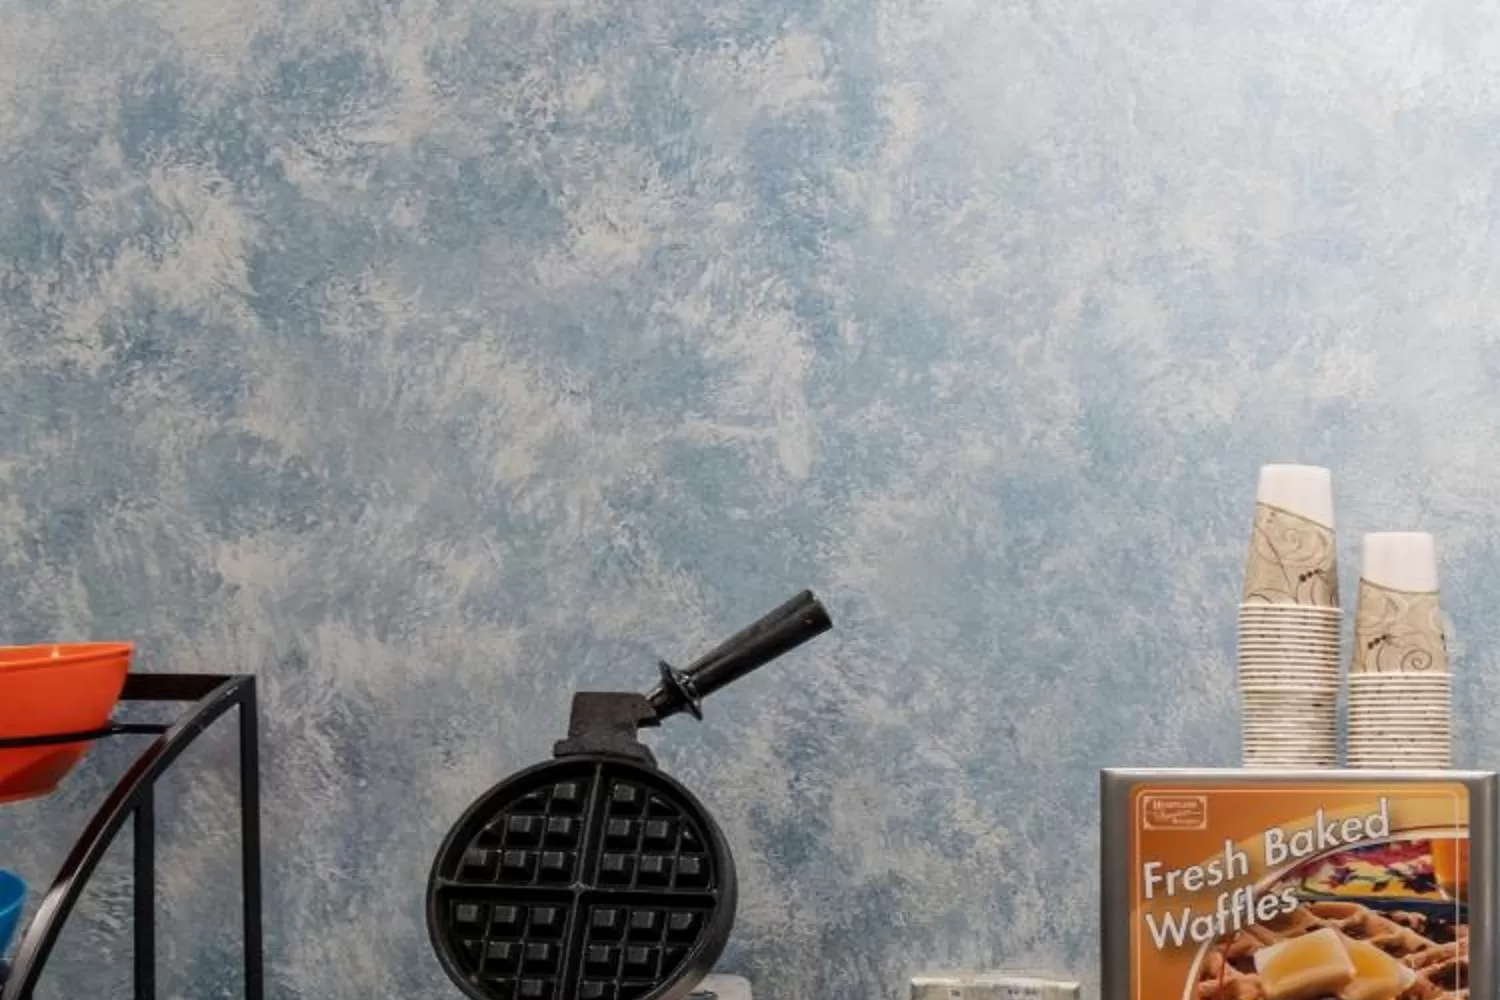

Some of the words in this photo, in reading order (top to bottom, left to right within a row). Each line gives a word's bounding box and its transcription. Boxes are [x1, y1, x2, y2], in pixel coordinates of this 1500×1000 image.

[1143, 838, 1249, 898] Fresh
[1264, 797, 1390, 867] Baked
[1145, 885, 1300, 950] Waffles
